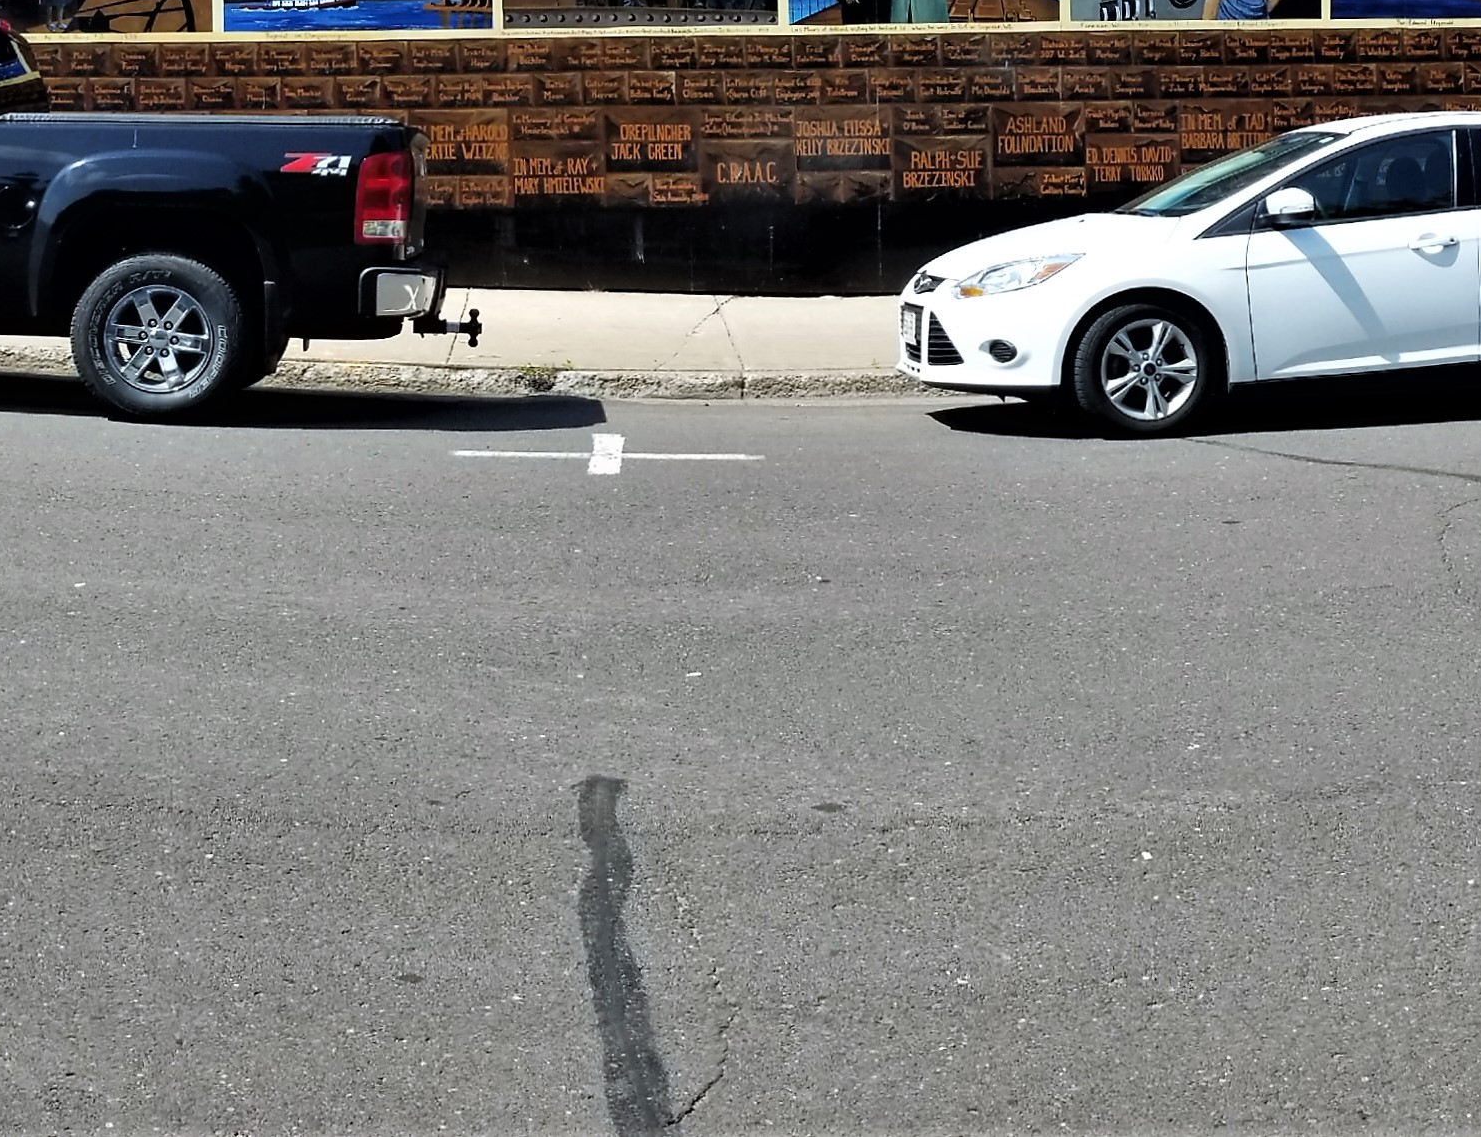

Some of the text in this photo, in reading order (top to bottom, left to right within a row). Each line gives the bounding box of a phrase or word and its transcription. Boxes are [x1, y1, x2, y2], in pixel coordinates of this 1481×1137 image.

[1006, 117, 1067, 133] ASHLAND
[1181, 114, 1195, 131] IN
[796, 138, 891, 155] KELLY BRZEZINSKI
[998, 135, 1074, 154] FOUNDATION
[1181, 133, 1225, 149] BARBARA
[611, 143, 682, 160] JACK GREEN
[280, 152, 353, 173] Z71
[513, 159, 526, 175] IN
[567, 158, 588, 175] RAY
[903, 170, 975, 188] BRZEZINSKI
[1093, 165, 1164, 182] TERRY TORKKO
[515, 177, 539, 194] MARY
